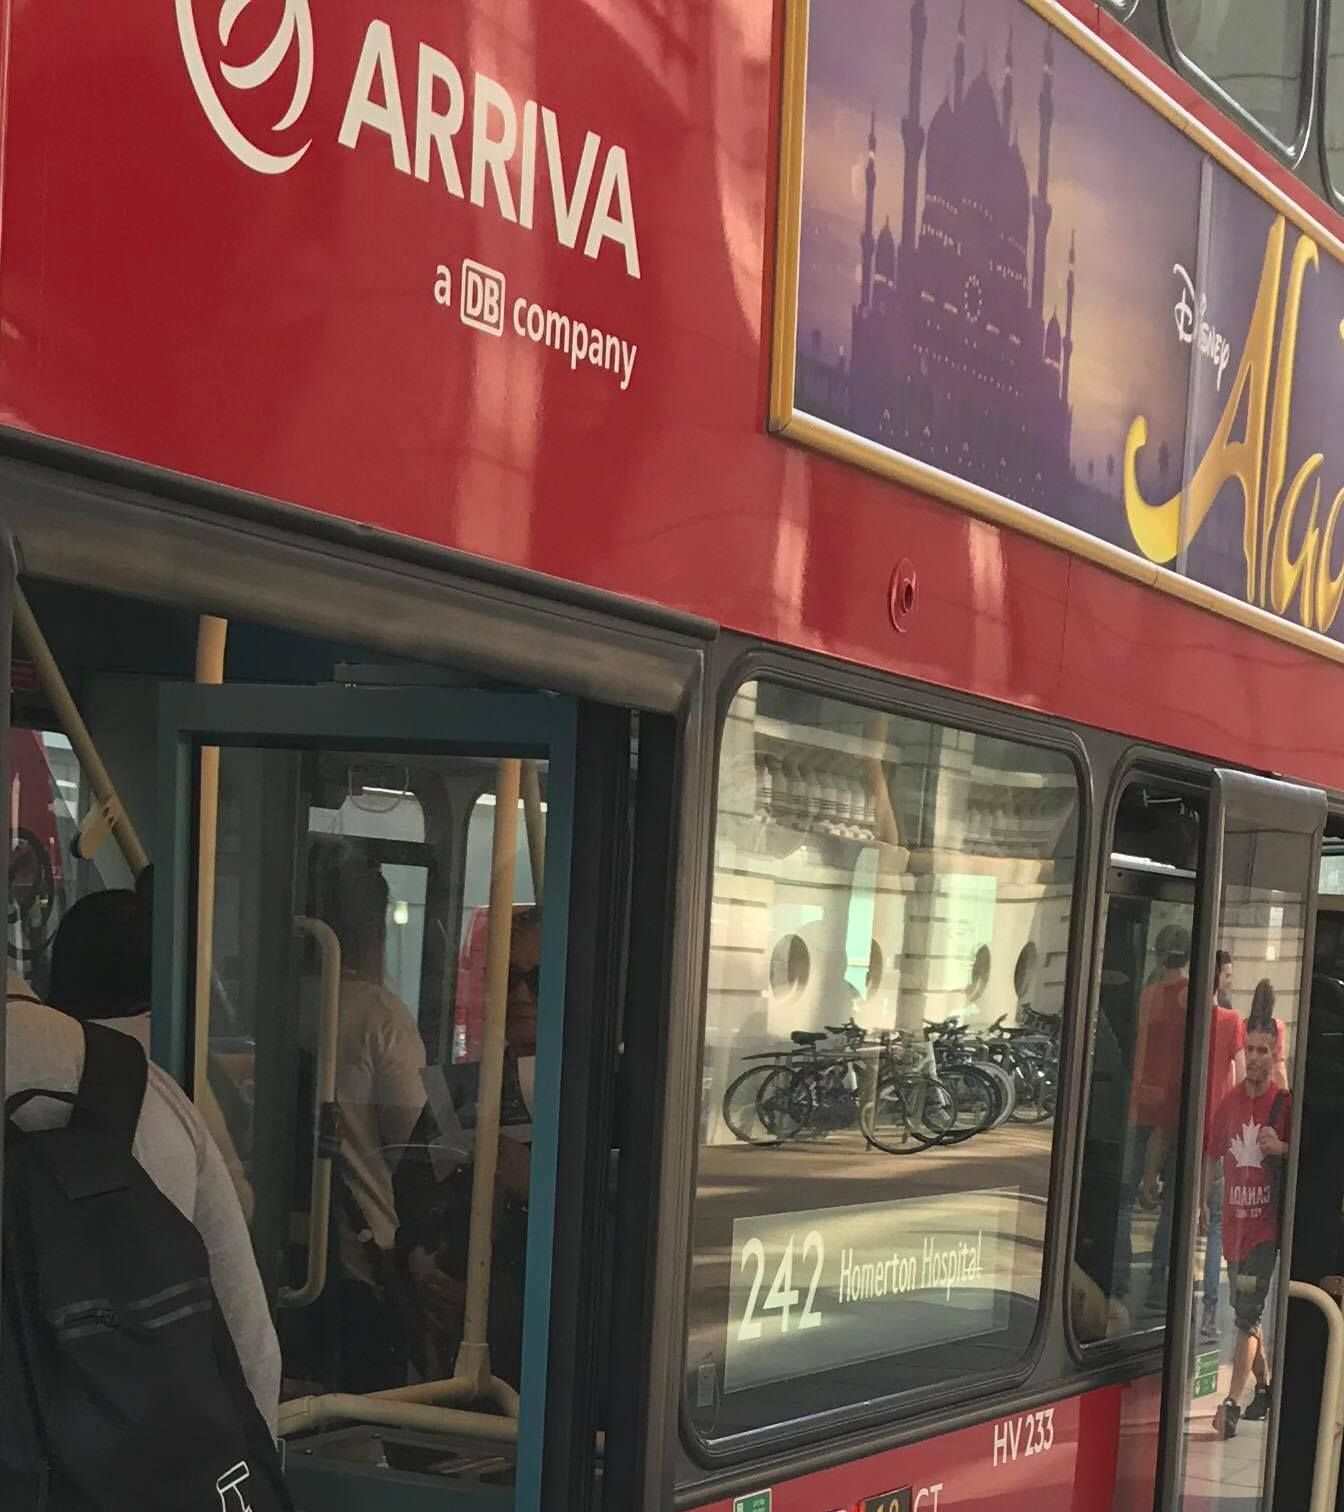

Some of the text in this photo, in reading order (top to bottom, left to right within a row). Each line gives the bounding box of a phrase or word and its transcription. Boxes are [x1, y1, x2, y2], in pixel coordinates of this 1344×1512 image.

[338, 20, 641, 280] ARRIVA
[434, 265, 637, 390] a DB company
[737, 1229, 984, 1341] 242 Homerton Hospital
[993, 1408, 1055, 1467] HV 233
